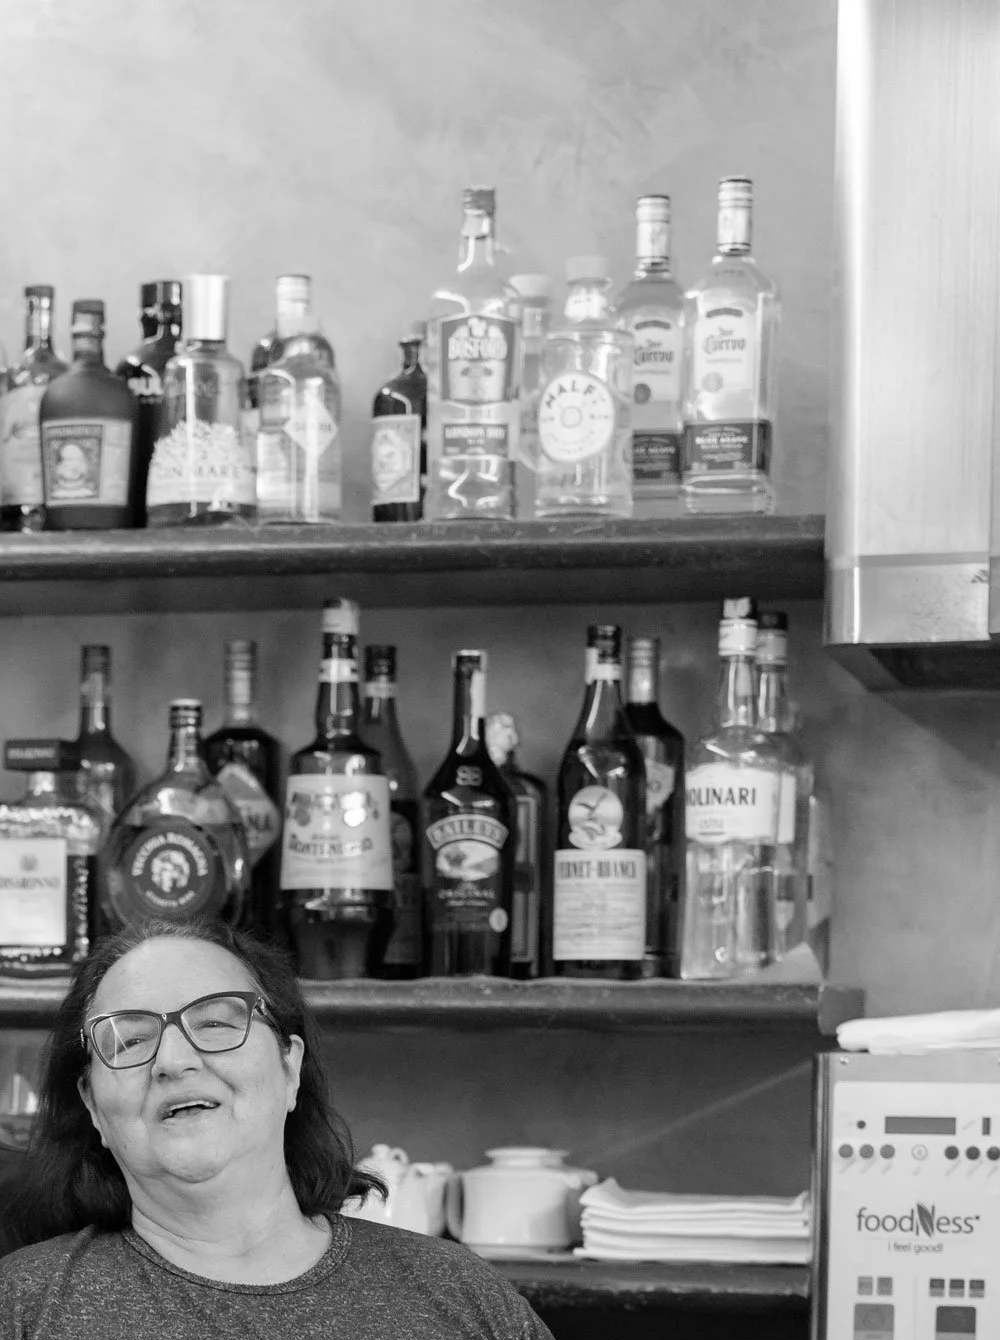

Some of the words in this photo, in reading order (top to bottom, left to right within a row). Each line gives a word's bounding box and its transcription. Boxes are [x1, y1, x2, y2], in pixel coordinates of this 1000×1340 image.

[545, 379, 607, 409] MALF
[686, 787, 757, 806] OLINARI
[893, 1241, 912, 1252] feel
